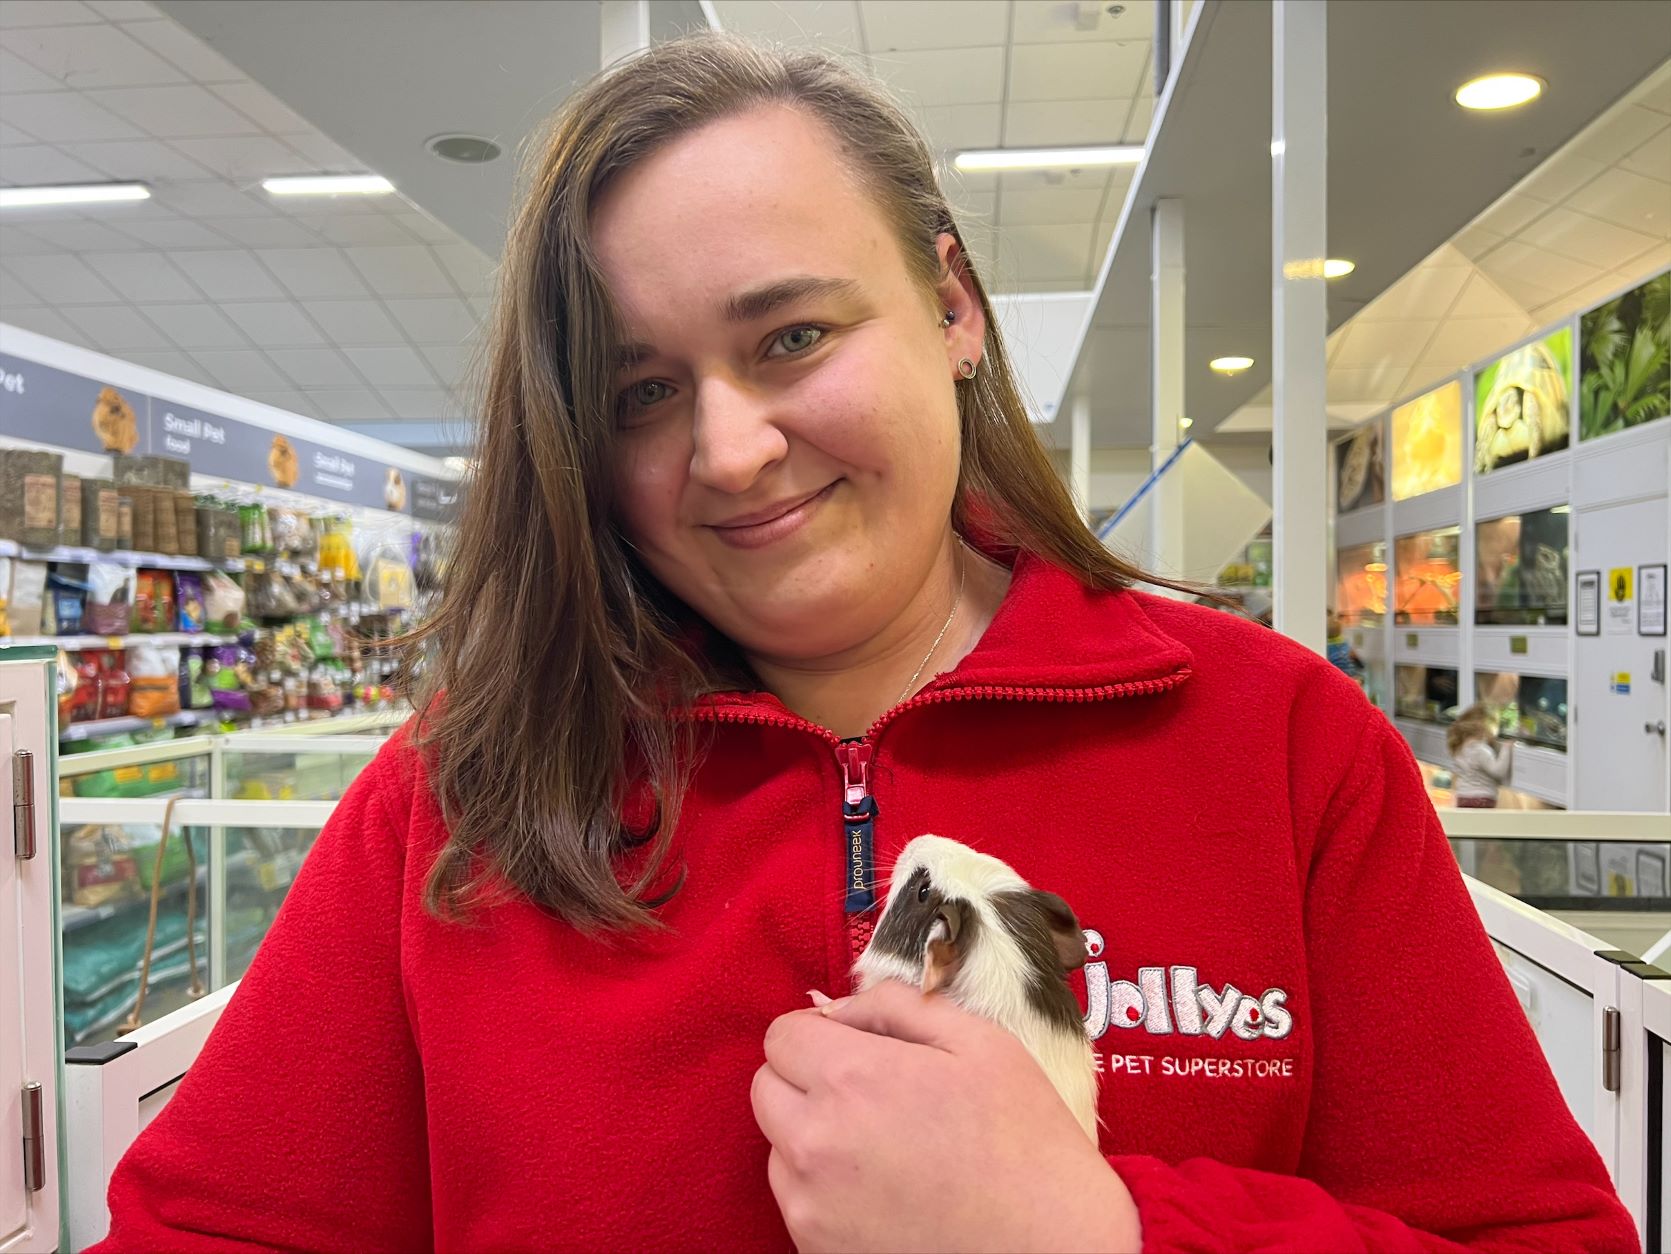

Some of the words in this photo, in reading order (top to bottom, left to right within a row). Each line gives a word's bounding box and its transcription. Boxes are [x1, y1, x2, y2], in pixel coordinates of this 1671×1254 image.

[164, 412, 202, 438] Small
[203, 422, 226, 445] Pet
[1083, 929, 1293, 1041] jollyes
[1111, 1054, 1154, 1075] PET
[1161, 1056, 1294, 1078] SUPERSTORE
